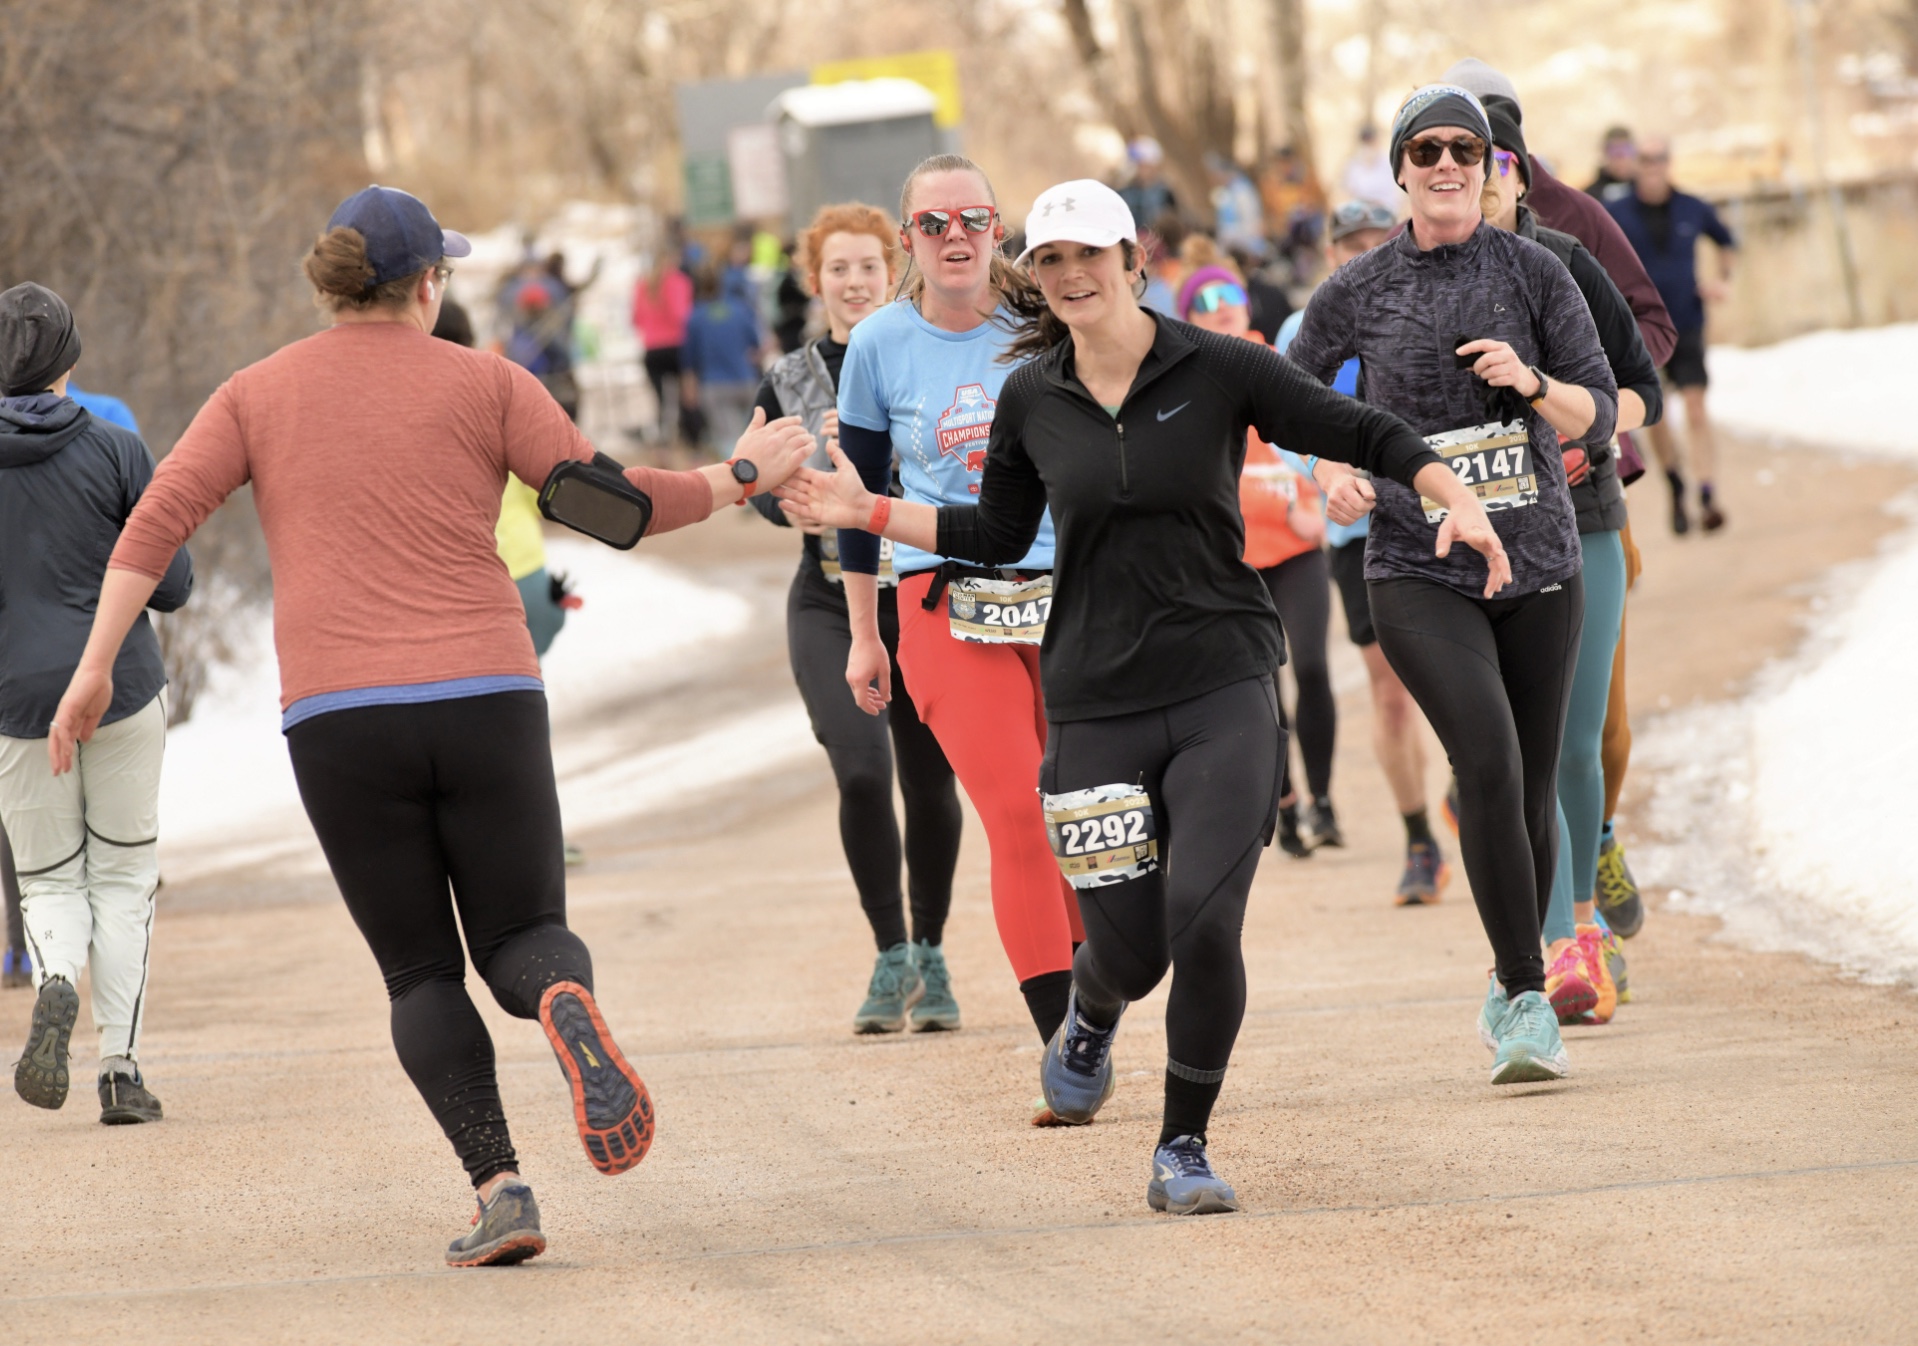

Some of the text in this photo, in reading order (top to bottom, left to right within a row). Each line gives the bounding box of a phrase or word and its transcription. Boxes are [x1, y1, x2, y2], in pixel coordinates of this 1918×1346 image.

[943, 410, 995, 428] MULTISPORT NATIO
[942, 425, 991, 448] CHAMPIONS
[1465, 442, 1479, 451] 10K
[1452, 445, 1525, 485] 2147
[1540, 584, 1562, 594] adidas
[982, 597, 1052, 627] 2047
[1073, 808, 1089, 818] 10K
[1061, 810, 1148, 855] 2292
